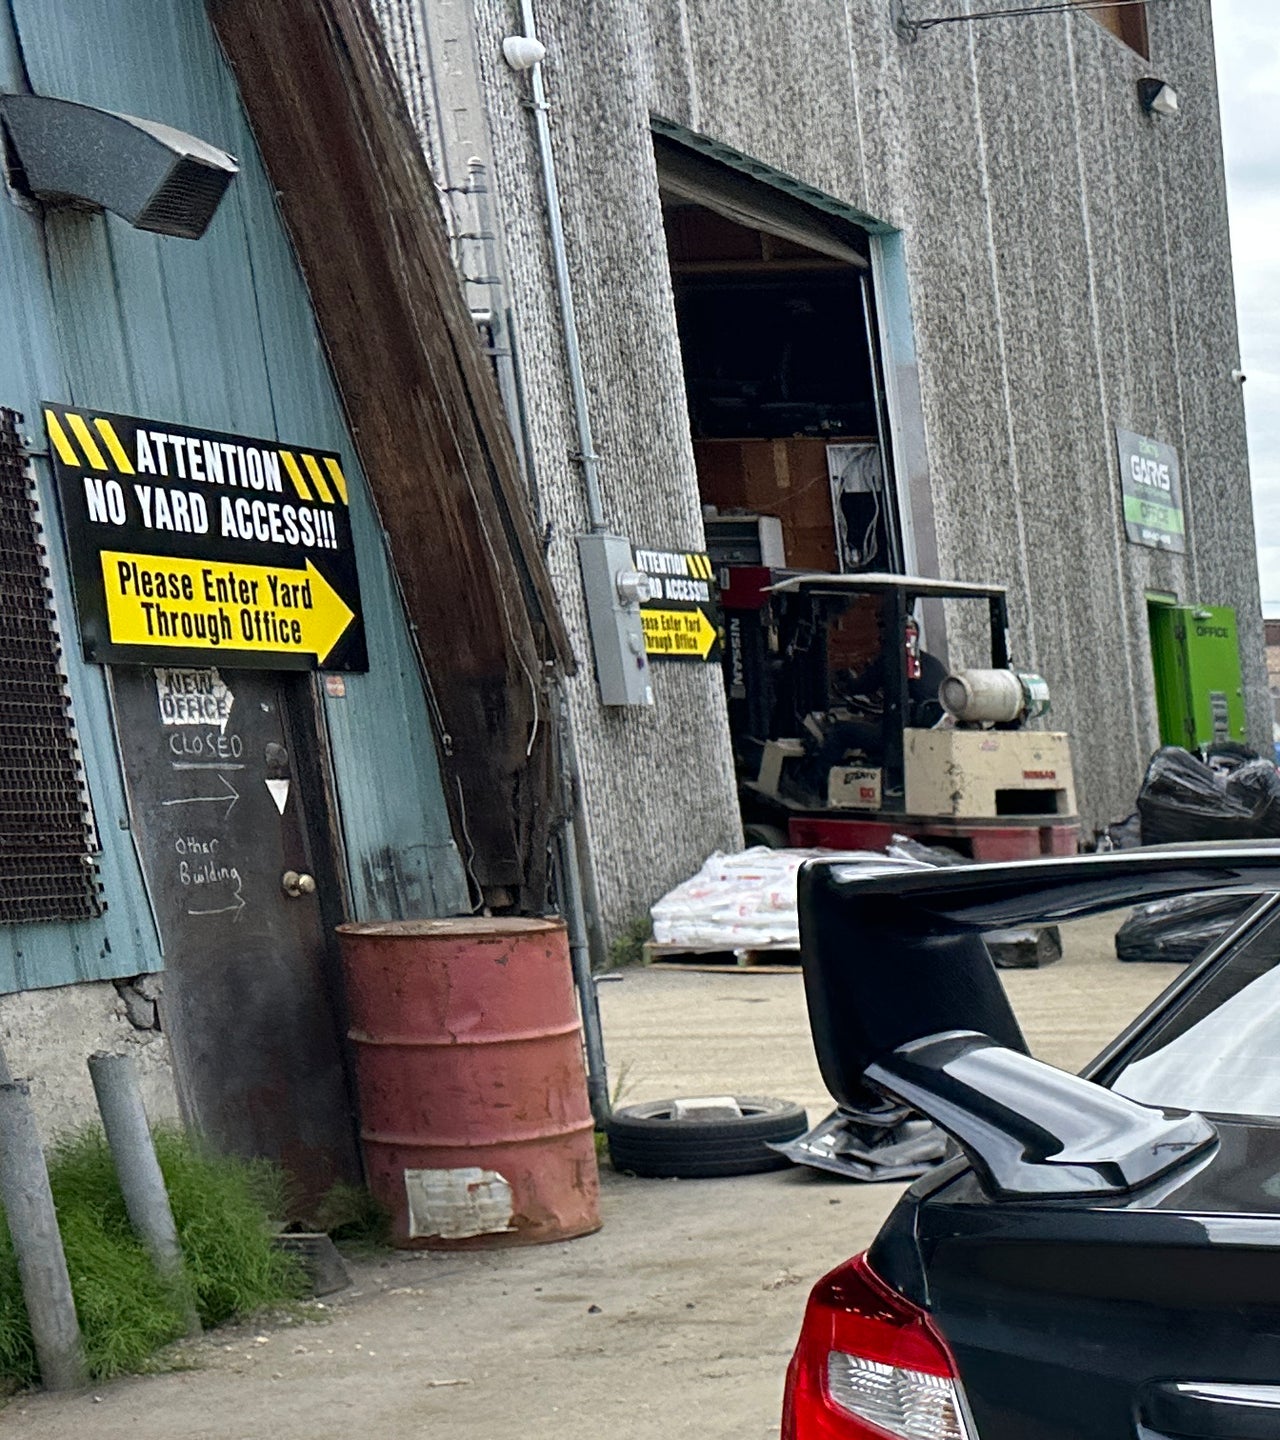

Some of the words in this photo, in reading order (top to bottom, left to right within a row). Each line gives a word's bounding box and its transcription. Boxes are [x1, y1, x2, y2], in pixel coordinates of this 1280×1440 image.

[136, 429, 283, 492] ATTENTION
[83, 477, 127, 526] NO
[134, 484, 209, 534] YARD
[220, 496, 338, 549] ACCESS!!!
[636, 550, 688, 576] ATTENTION
[117, 560, 194, 601] Please
[202, 568, 259, 606] Enter
[267, 574, 313, 610] Yard
[140, 602, 232, 645] Through
[240, 610, 302, 644] Office
[641, 616, 659, 631] ease
[660, 614, 682, 632] Enter
[684, 617, 702, 633] Yard
[1196, 626, 1228, 638] OFFICE
[675, 633, 699, 650] Office
[162, 694, 227, 719] OFFICE
[169, 732, 243, 758] CLOSED
[175, 837, 219, 854] Other
[179, 861, 242, 893] Building
